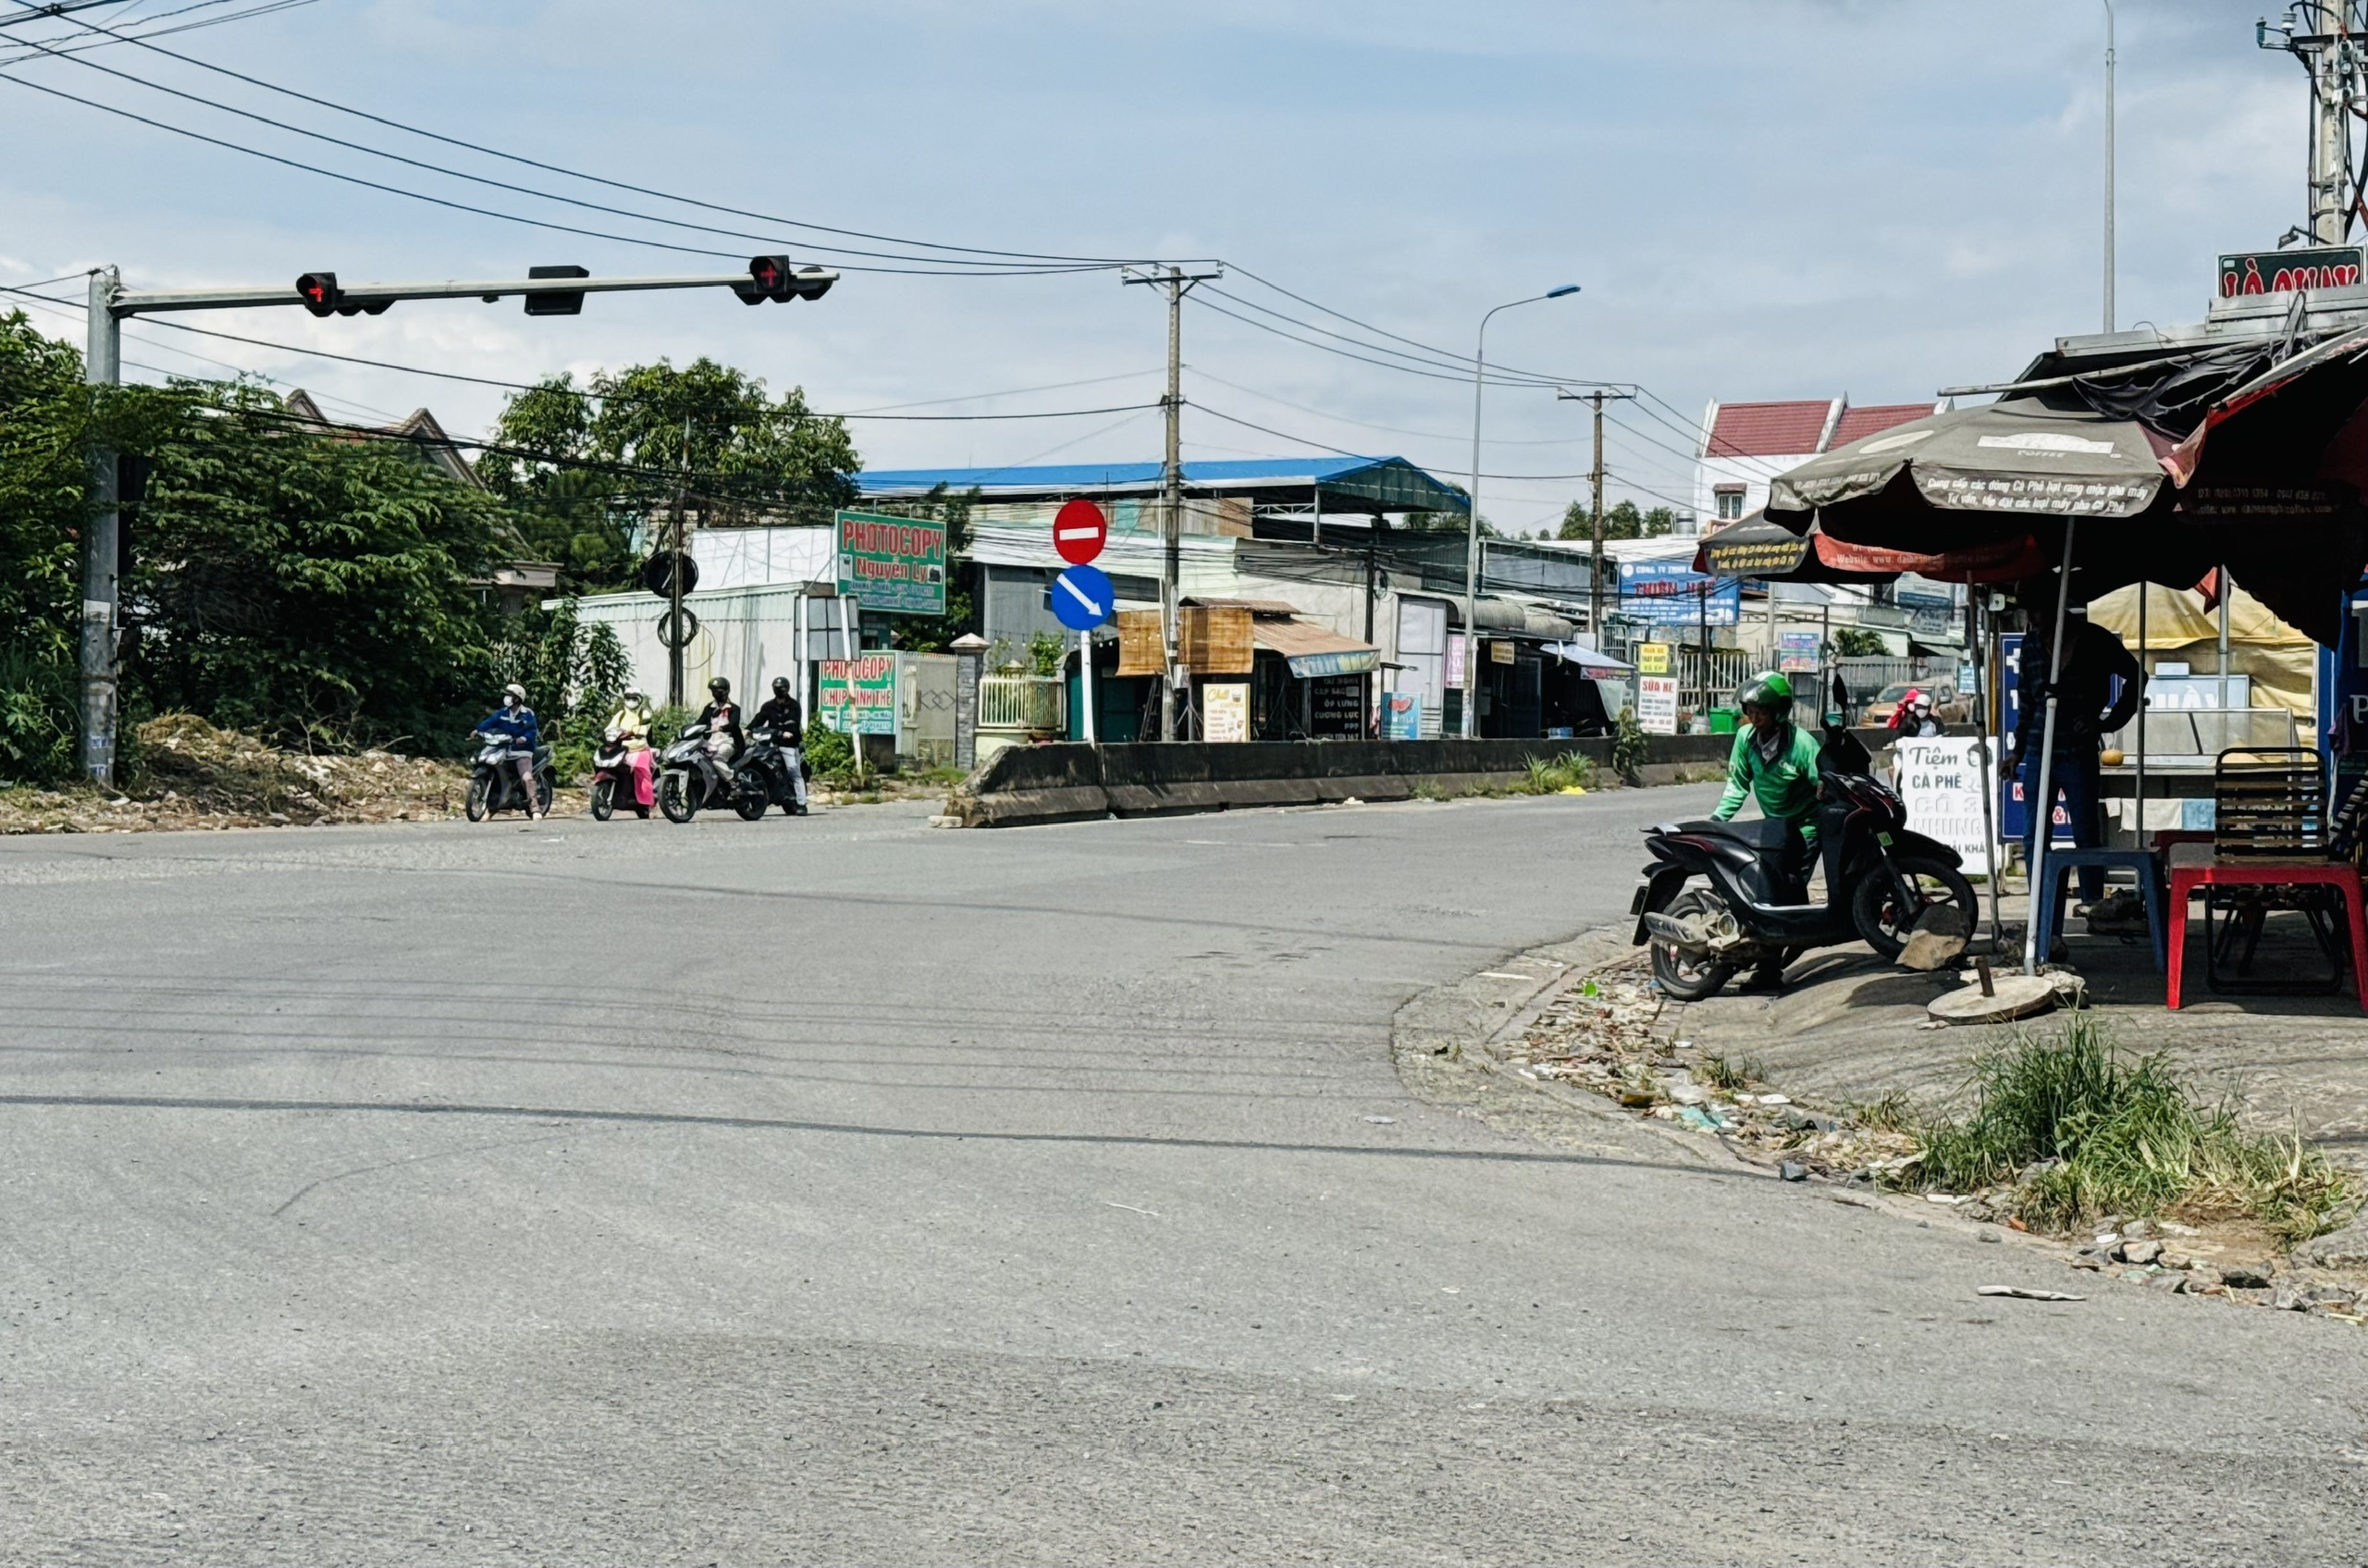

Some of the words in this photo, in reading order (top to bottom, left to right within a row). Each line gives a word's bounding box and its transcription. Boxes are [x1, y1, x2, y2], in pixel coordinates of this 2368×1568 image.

[842, 519, 943, 560] PHOTOCOPY
[1908, 746, 1958, 771] Tiệm
[1911, 772, 1930, 789] CÀ
[1934, 772, 1963, 789] PHÊ
